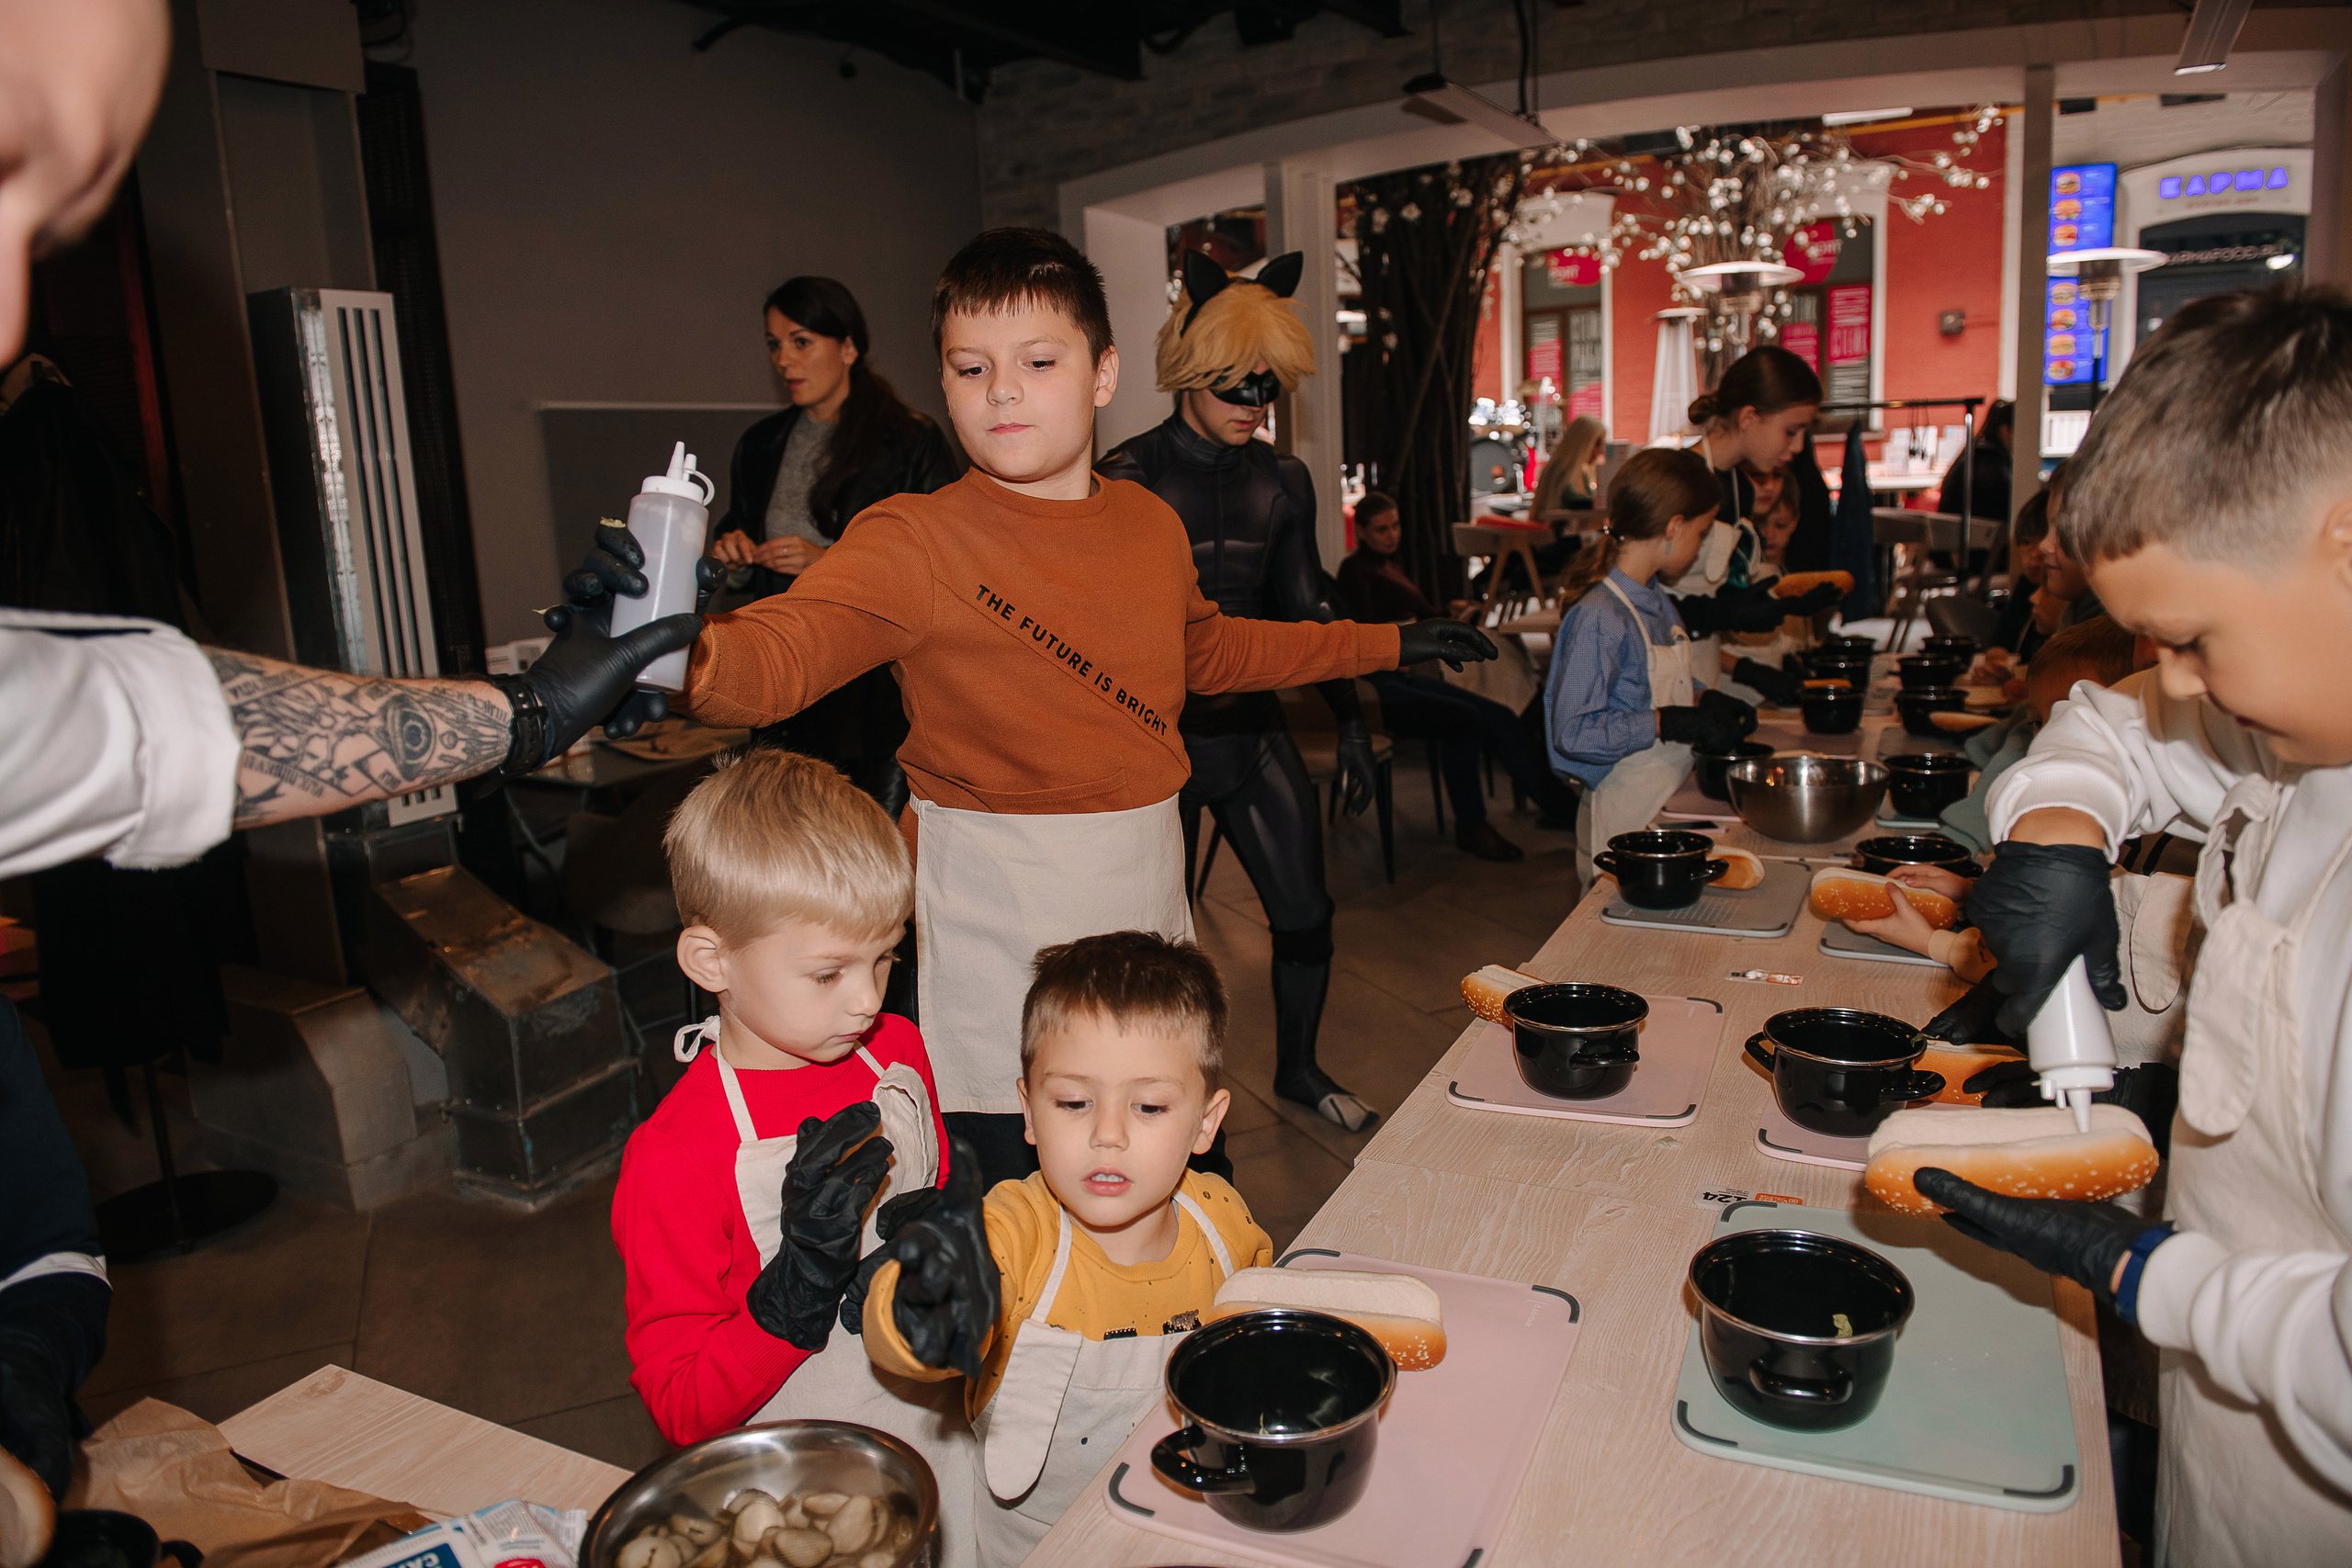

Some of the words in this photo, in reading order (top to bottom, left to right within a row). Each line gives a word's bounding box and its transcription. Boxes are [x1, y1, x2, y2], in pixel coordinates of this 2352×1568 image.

[976, 584, 1016, 621] THE
[1019, 615, 1093, 678] FUTURE
[1093, 671, 1114, 693] IS
[1115, 688, 1168, 737] BRIGHT
